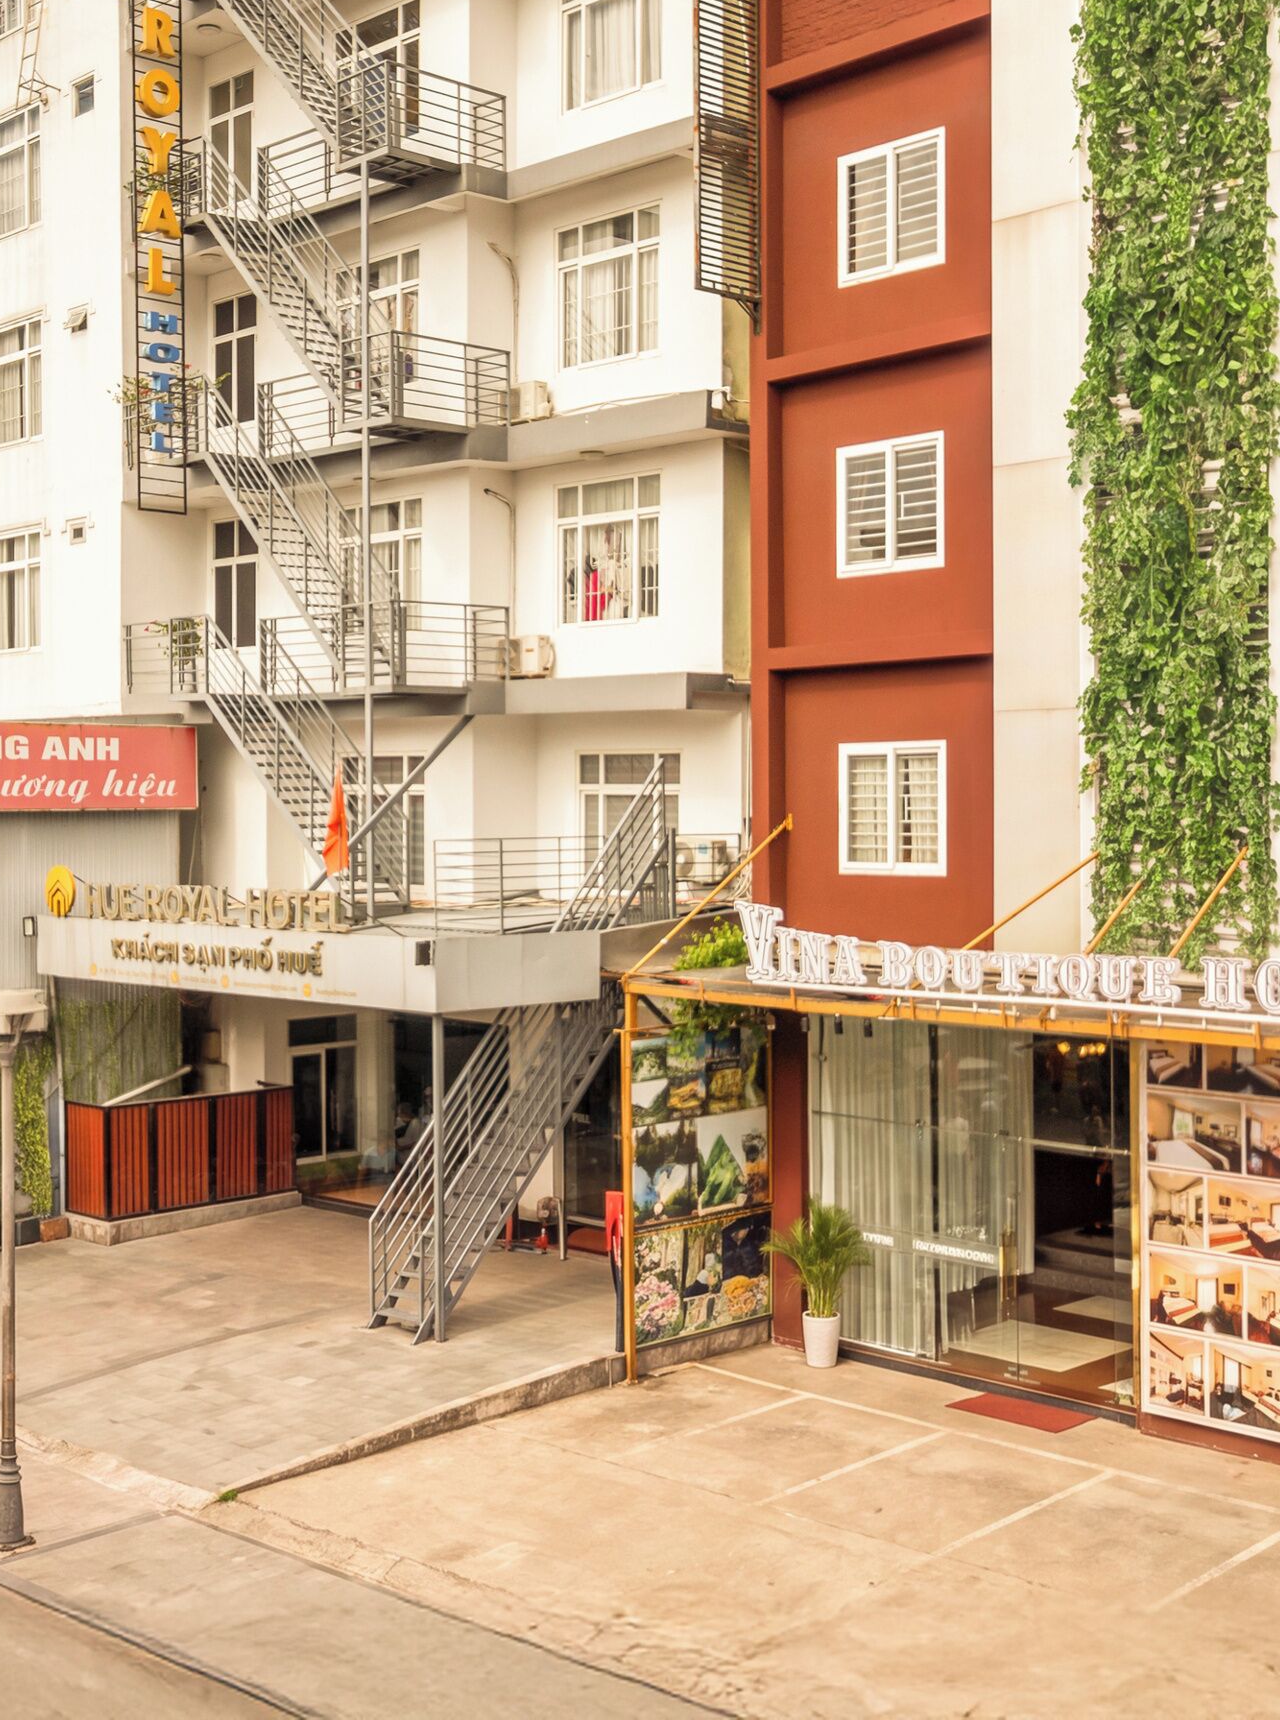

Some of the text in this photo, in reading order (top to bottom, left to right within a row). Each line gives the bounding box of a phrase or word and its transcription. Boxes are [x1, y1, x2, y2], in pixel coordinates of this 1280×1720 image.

[142, 311, 180, 453] HOTEL
[41, 736, 119, 761] ANH
[102, 768, 178, 803] hiệu
[84, 882, 353, 934] HUE ROYAL HOTEL
[111, 931, 180, 964] KHÁCH
[182, 942, 226, 973] SẠN
[277, 940, 324, 977] HUẾ
[733, 901, 867, 986] VINA
[877, 939, 1183, 1005] BOUTIQUE
